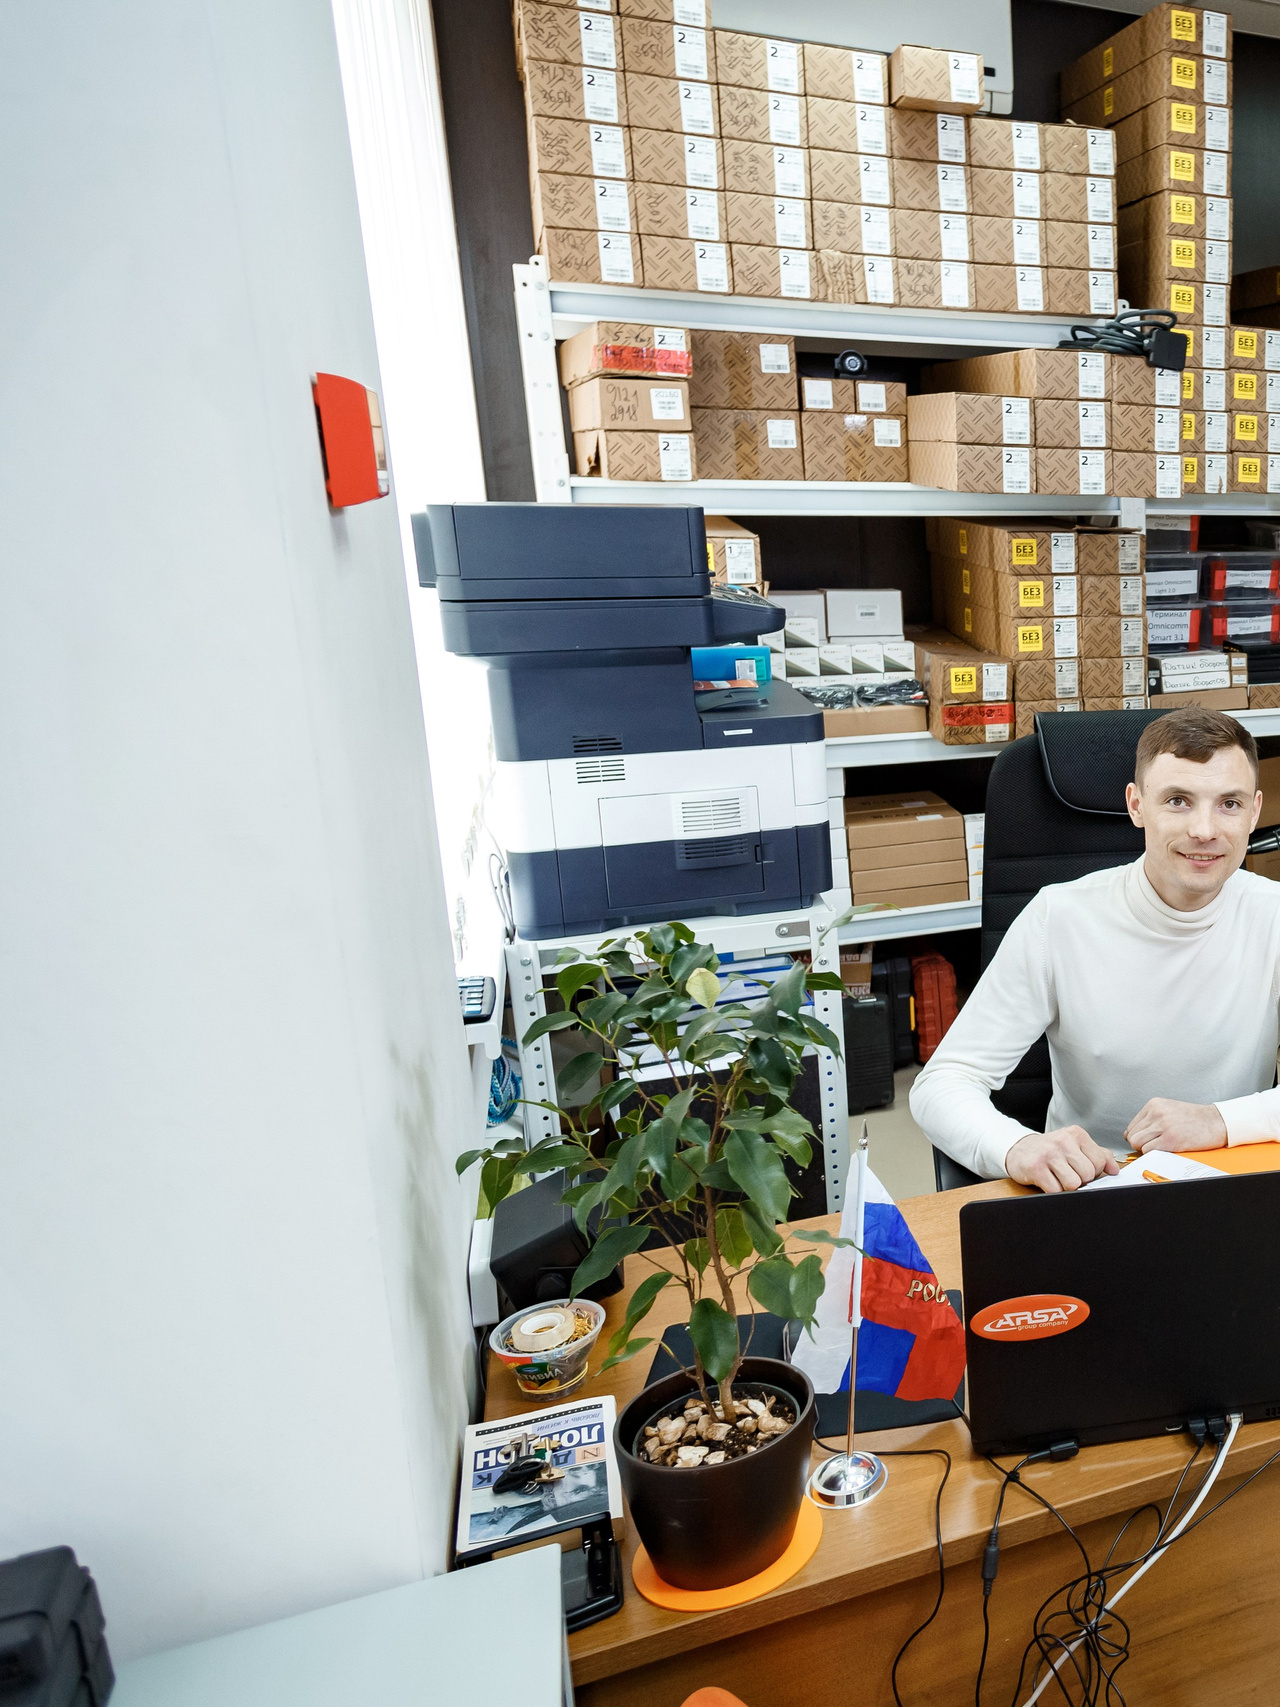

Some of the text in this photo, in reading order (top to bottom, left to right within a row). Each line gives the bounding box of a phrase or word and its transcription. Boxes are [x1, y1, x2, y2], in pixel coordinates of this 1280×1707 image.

[1176, 18, 1192, 29] БЕЗ
[770, 47, 778, 57] 2
[1177, 65, 1193, 77] БЕЗ
[586, 75, 596, 85] 2
[1176, 110, 1192, 121] БЕЗ
[940, 120, 948, 130] 2
[1090, 135, 1097, 145] 2
[941, 171, 949, 180] 2
[599, 186, 608, 196] 2
[1090, 183, 1097, 192] 2
[777, 205, 786, 214] 2
[698, 249, 707, 258] 2
[1092, 277, 1099, 286] 2
[1175, 292, 1192, 302] БЕЗ
[1205, 289, 1212, 297] 2
[657, 335, 667, 345] 2
[1267, 336, 1274, 344] 2
[1081, 408, 1089, 417] 2
[1206, 417, 1213, 425] 2
[1239, 421, 1255, 430] БЕЗ
[1005, 454, 1013, 463] 2
[1081, 456, 1089, 465] 2
[1242, 464, 1258, 472] БЕЗ
[1052, 538, 1060, 546] 2
[1016, 545, 1034, 554] БЕЗ
[1023, 588, 1041, 596] БЕЗ
[1022, 633, 1040, 641] БЕЗ
[996, 1307, 1069, 1329] ARSA
[1038, 1320, 1069, 1329] company
